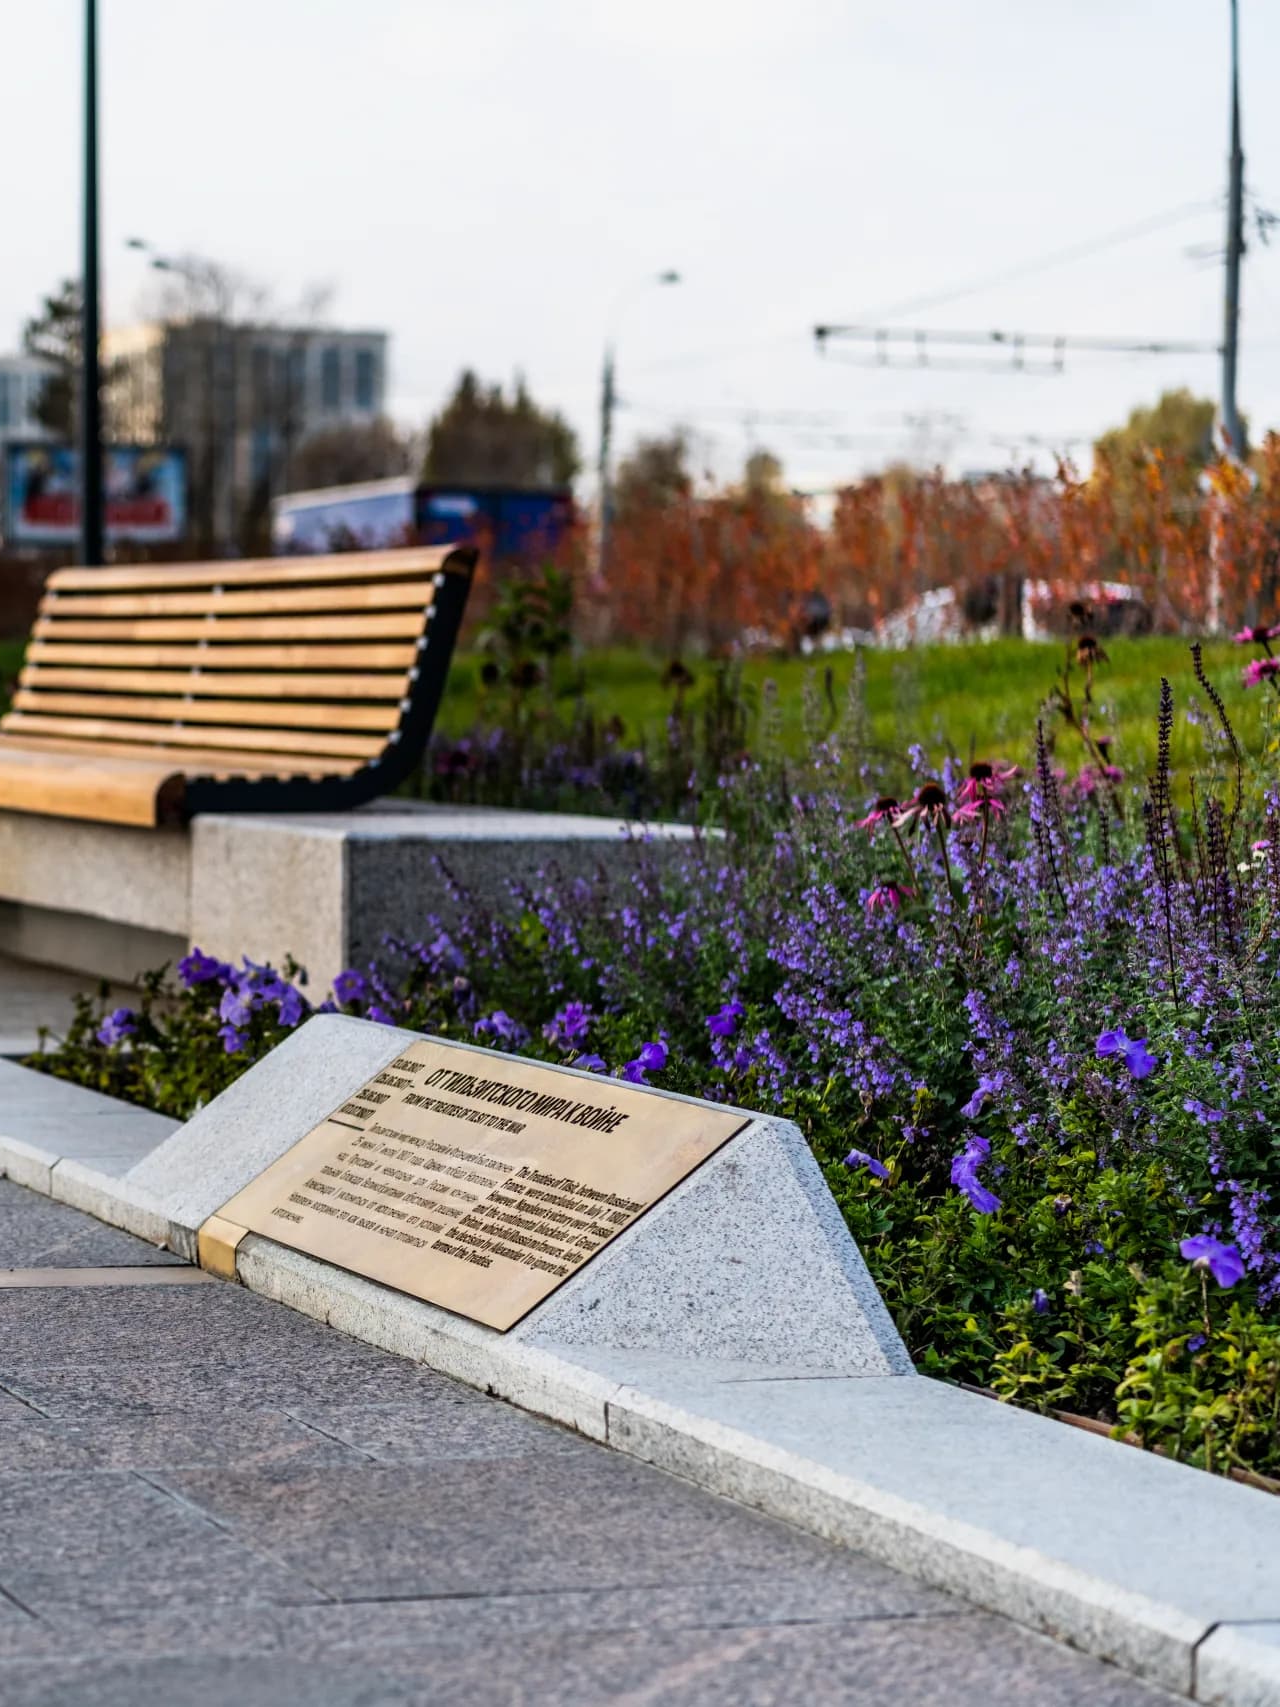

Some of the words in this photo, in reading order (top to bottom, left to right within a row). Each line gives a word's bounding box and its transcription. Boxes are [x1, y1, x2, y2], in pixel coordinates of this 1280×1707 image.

[424, 1068, 453, 1087] ОТ
[440, 1072, 538, 1110] ТИЛЬЗИТСКОГО
[401, 1092, 426, 1106] FROM
[418, 1097, 437, 1110] THE
[430, 1100, 464, 1117] TREATIES
[456, 1108, 473, 1119] OF
[465, 1110, 491, 1124] TILSIT
[483, 1115, 500, 1127] TO
[492, 1117, 513, 1131] THE
[504, 1121, 527, 1135] WAR
[525, 1094, 573, 1120] МИРА
[559, 1102, 586, 1123] К
[570, 1105, 629, 1133] ВОЙНЕ
[514, 1166, 531, 1179] The
[526, 1169, 556, 1186] Treaties
[550, 1177, 567, 1188] of
[558, 1179, 580, 1195] Tilsit,
[575, 1184, 609, 1202] between
[603, 1193, 631, 1209] Russia
[500, 1178, 527, 1195] France,
[524, 1188, 545, 1200] were
[540, 1193, 583, 1210] concluded
[574, 1203, 589, 1213] on
[583, 1204, 604, 1220] July
[598, 1208, 612, 1220] 7,
[606, 1210, 631, 1226] 1807.
[624, 1202, 648, 1213] and
[486, 1190, 518, 1208] However,
[513, 1198, 553, 1219] Napoleon's
[547, 1210, 574, 1228] victory
[567, 1219, 590, 1231] over
[580, 1221, 614, 1239] Prussia
[444, 1226, 460, 1239] the
[471, 1204, 493, 1215] and
[484, 1206, 501, 1219] the
[496, 1212, 542, 1231] continental
[533, 1222, 570, 1242] blockade
[565, 1233, 583, 1245] of
[574, 1235, 601, 1252] Great
[430, 1239, 453, 1254] terms
[455, 1230, 486, 1248] decision
[458, 1214, 484, 1231] Britain,
[480, 1222, 505, 1236] which
[497, 1227, 517, 1240] did
[507, 1230, 533, 1247] Russia
[526, 1239, 541, 1250] no
[535, 1239, 565, 1258] favours,
[561, 1248, 581, 1262] led
[571, 1253, 584, 1265] to
[479, 1238, 494, 1253] by
[447, 1244, 464, 1256] of
[453, 1246, 470, 1260] the
[464, 1249, 494, 1268] Treaties.
[488, 1242, 526, 1261] Alexander
[519, 1252, 532, 1263] I
[523, 1254, 537, 1266] to
[530, 1256, 558, 1273] ignore
[552, 1264, 569, 1278] the
